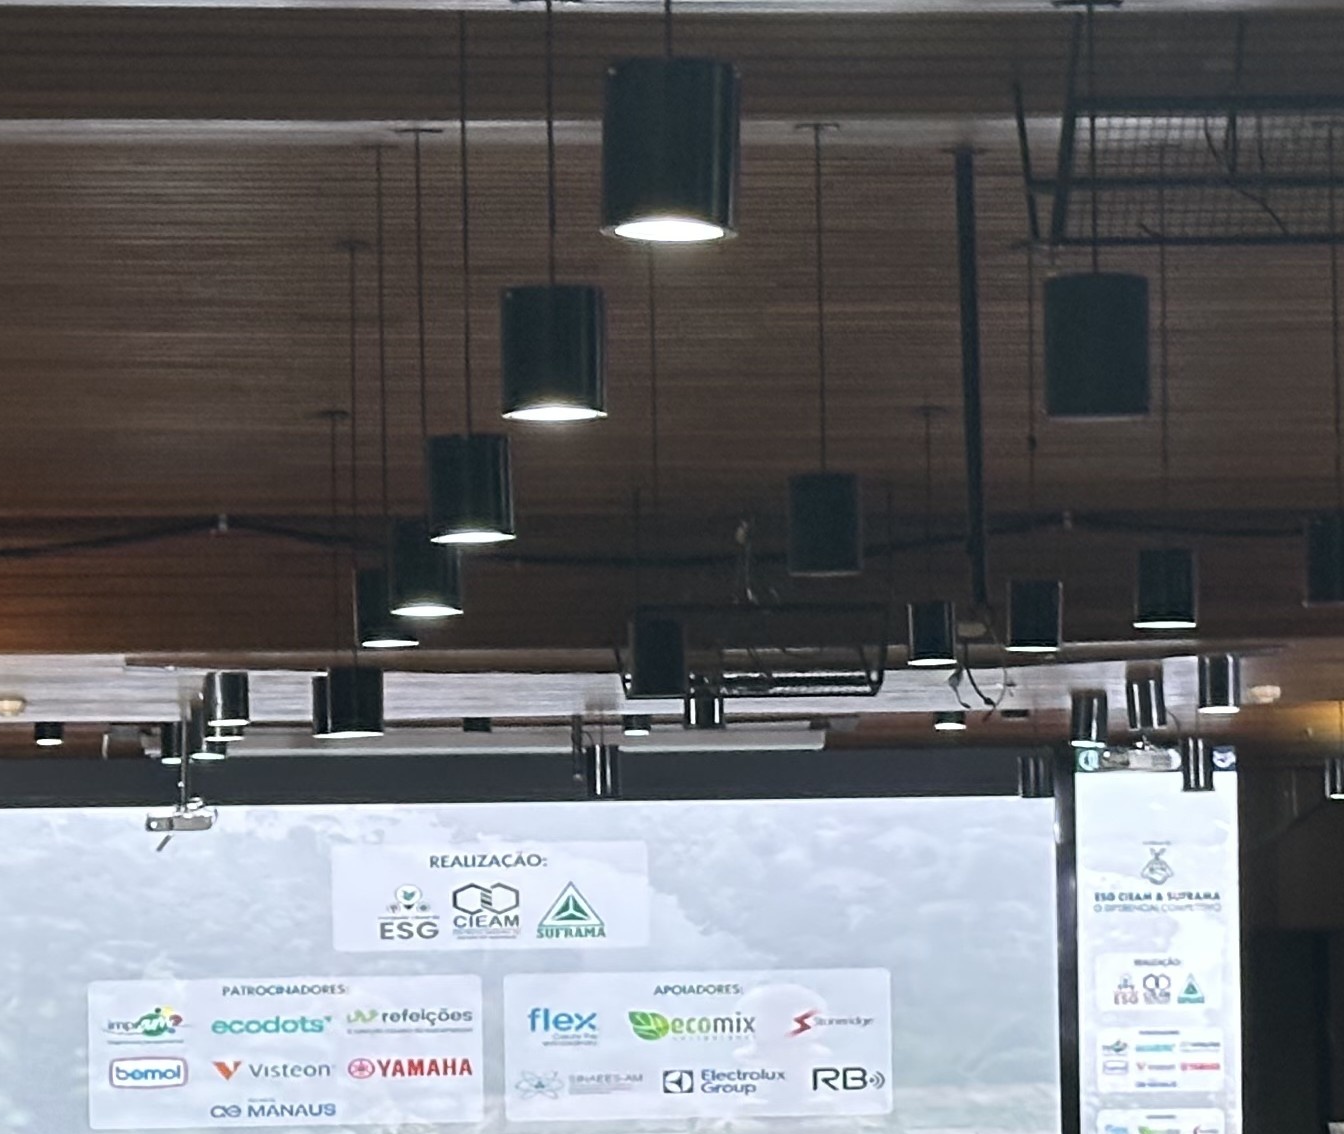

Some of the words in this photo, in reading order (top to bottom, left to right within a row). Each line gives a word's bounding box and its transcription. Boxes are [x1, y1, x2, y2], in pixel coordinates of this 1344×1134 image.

[429, 850, 548, 868] REALIZAÇÃO:
[453, 914, 520, 928] CIEAM
[380, 921, 439, 940] ESG
[536, 926, 606, 939] SUFRAMA
[211, 1015, 325, 1034] ecodots
[382, 1008, 473, 1026] refeições
[527, 1007, 597, 1032] flex
[671, 1011, 756, 1034] ecomix
[248, 1063, 332, 1078] Visteon
[376, 1058, 473, 1077] YAMAHA
[701, 1068, 786, 1082] Electrolux
[812, 1067, 868, 1091] RB
[701, 1081, 757, 1096] Group
[247, 1103, 337, 1118] MANAUS
